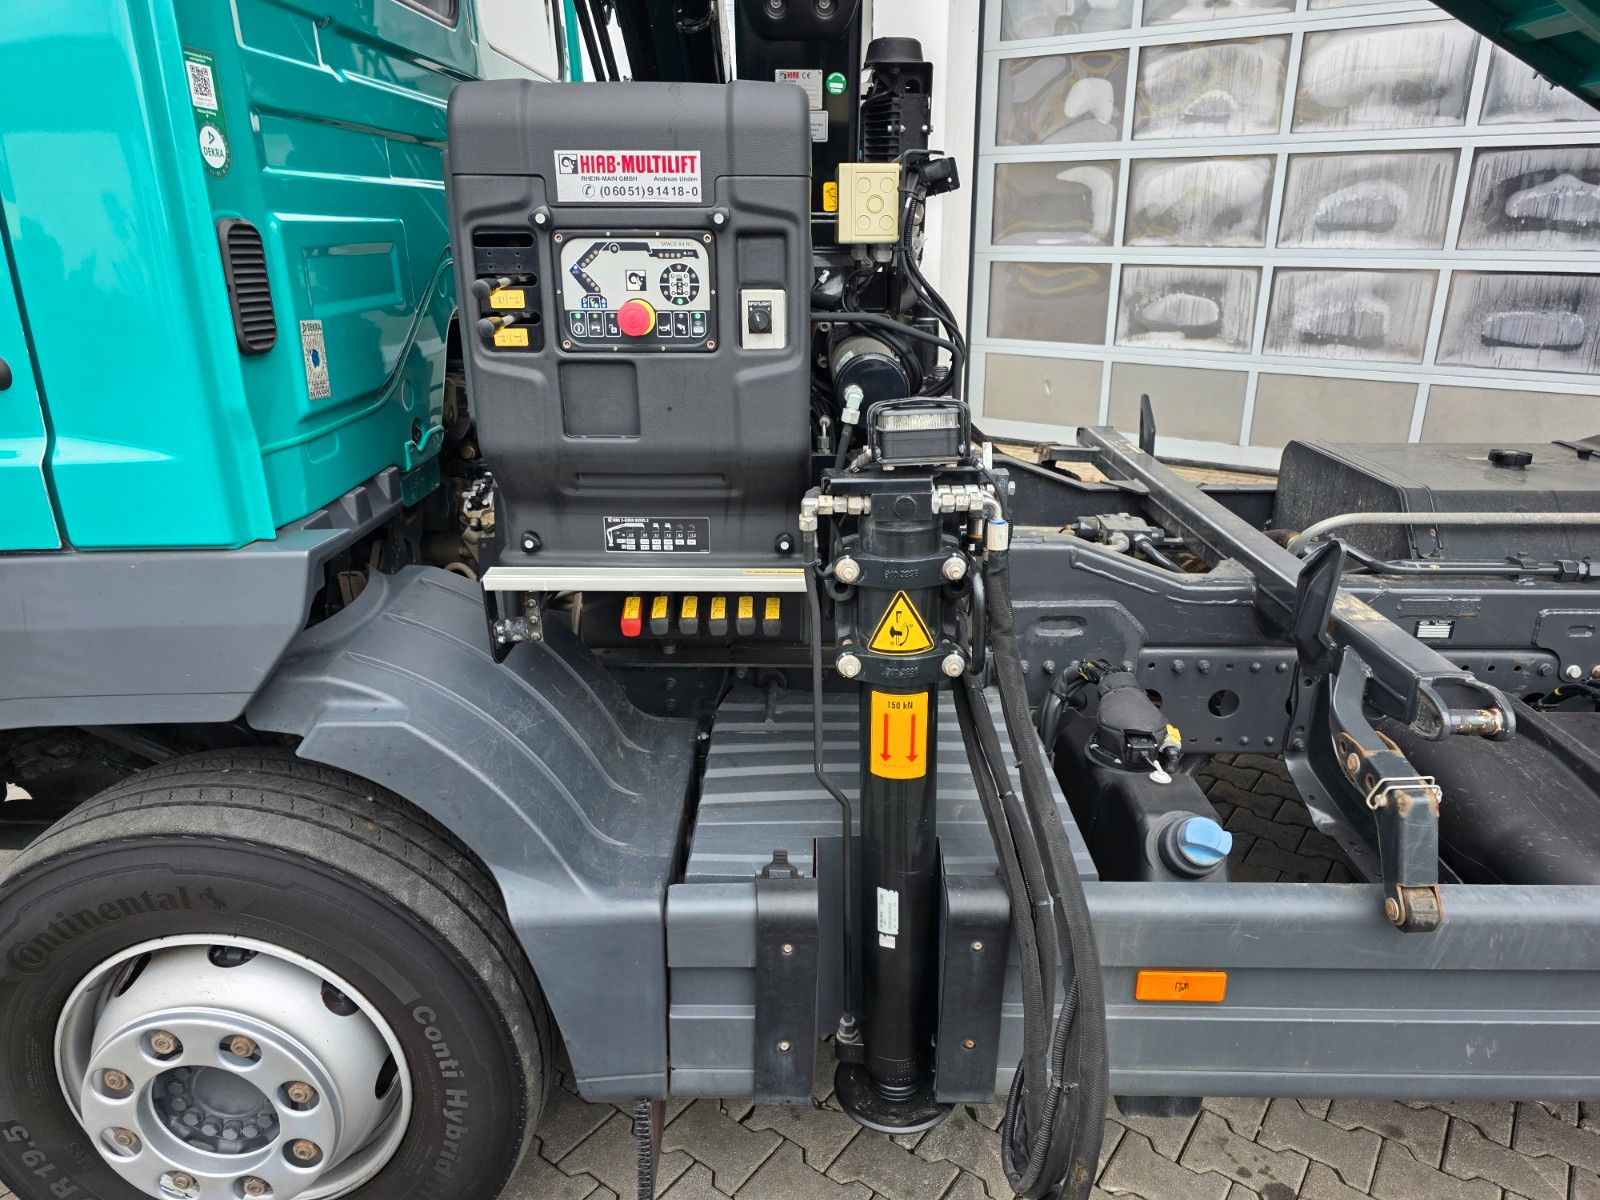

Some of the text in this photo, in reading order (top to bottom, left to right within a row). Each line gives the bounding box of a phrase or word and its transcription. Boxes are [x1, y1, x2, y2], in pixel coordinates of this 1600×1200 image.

[203, 146, 225, 158] DEKRA
[887, 700, 914, 710] 150 kN
[7, 885, 195, 973] Continental
[413, 1006, 469, 1179] Conti Hybrid
[3, 1126, 79, 1200] R 19.5
